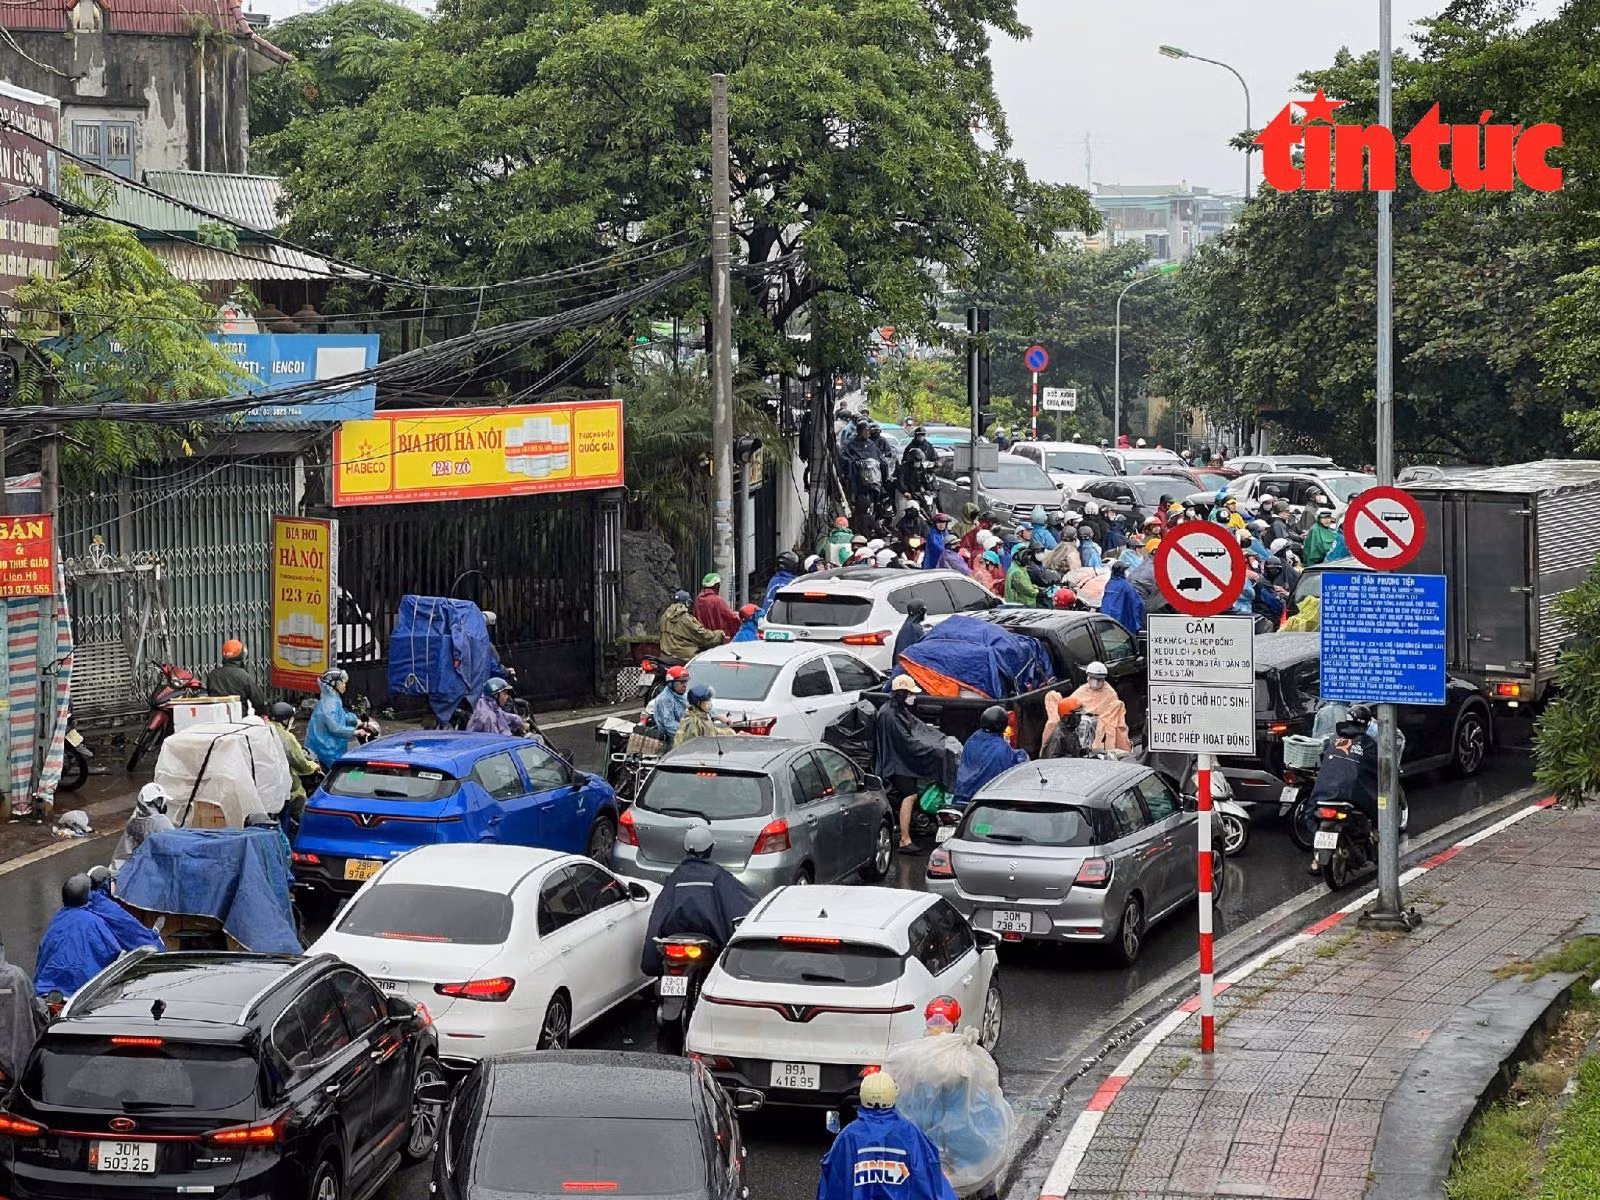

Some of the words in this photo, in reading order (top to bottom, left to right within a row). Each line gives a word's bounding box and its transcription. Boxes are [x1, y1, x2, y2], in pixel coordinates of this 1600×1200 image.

[399, 433, 423, 454] BIA
[424, 432, 452, 452] HƠI
[454, 426, 475, 451] HÀ
[477, 426, 502, 454] NỘI
[578, 439, 600, 453] QUỐC
[602, 442, 615, 452] GIA
[346, 462, 386, 474] HABECO
[432, 460, 452, 476] 123
[286, 526, 300, 540] BIA
[302, 528, 318, 541] HƠI
[280, 545, 298, 568] HÀ
[300, 547, 324, 574] NỘI
[34, 584, 50, 593] 555
[282, 587, 302, 602] 123
[1186, 618, 1215, 634] CẤM
[1181, 667, 1194, 677] TẤN
[1170, 692, 1176, 705] Ô
[1179, 692, 1189, 705] TÔ
[1191, 692, 1208, 705] CHỞ
[1229, 697, 1250, 708] SINH
[1171, 710, 1192, 724] BUÝT
[1154, 733, 1176, 745] ĐƯỢC
[1180, 730, 1200, 744] PHÉP
[1203, 734, 1224, 747] HOẠT
[1227, 733, 1250, 748] ĐỘNG
[1004, 912, 1020, 921] 30M
[997, 921, 1027, 931] 738.35
[776, 1076, 814, 1088] 418.95
[115, 1142, 140, 1156] 30M
[104, 1157, 149, 1171] 503.26
